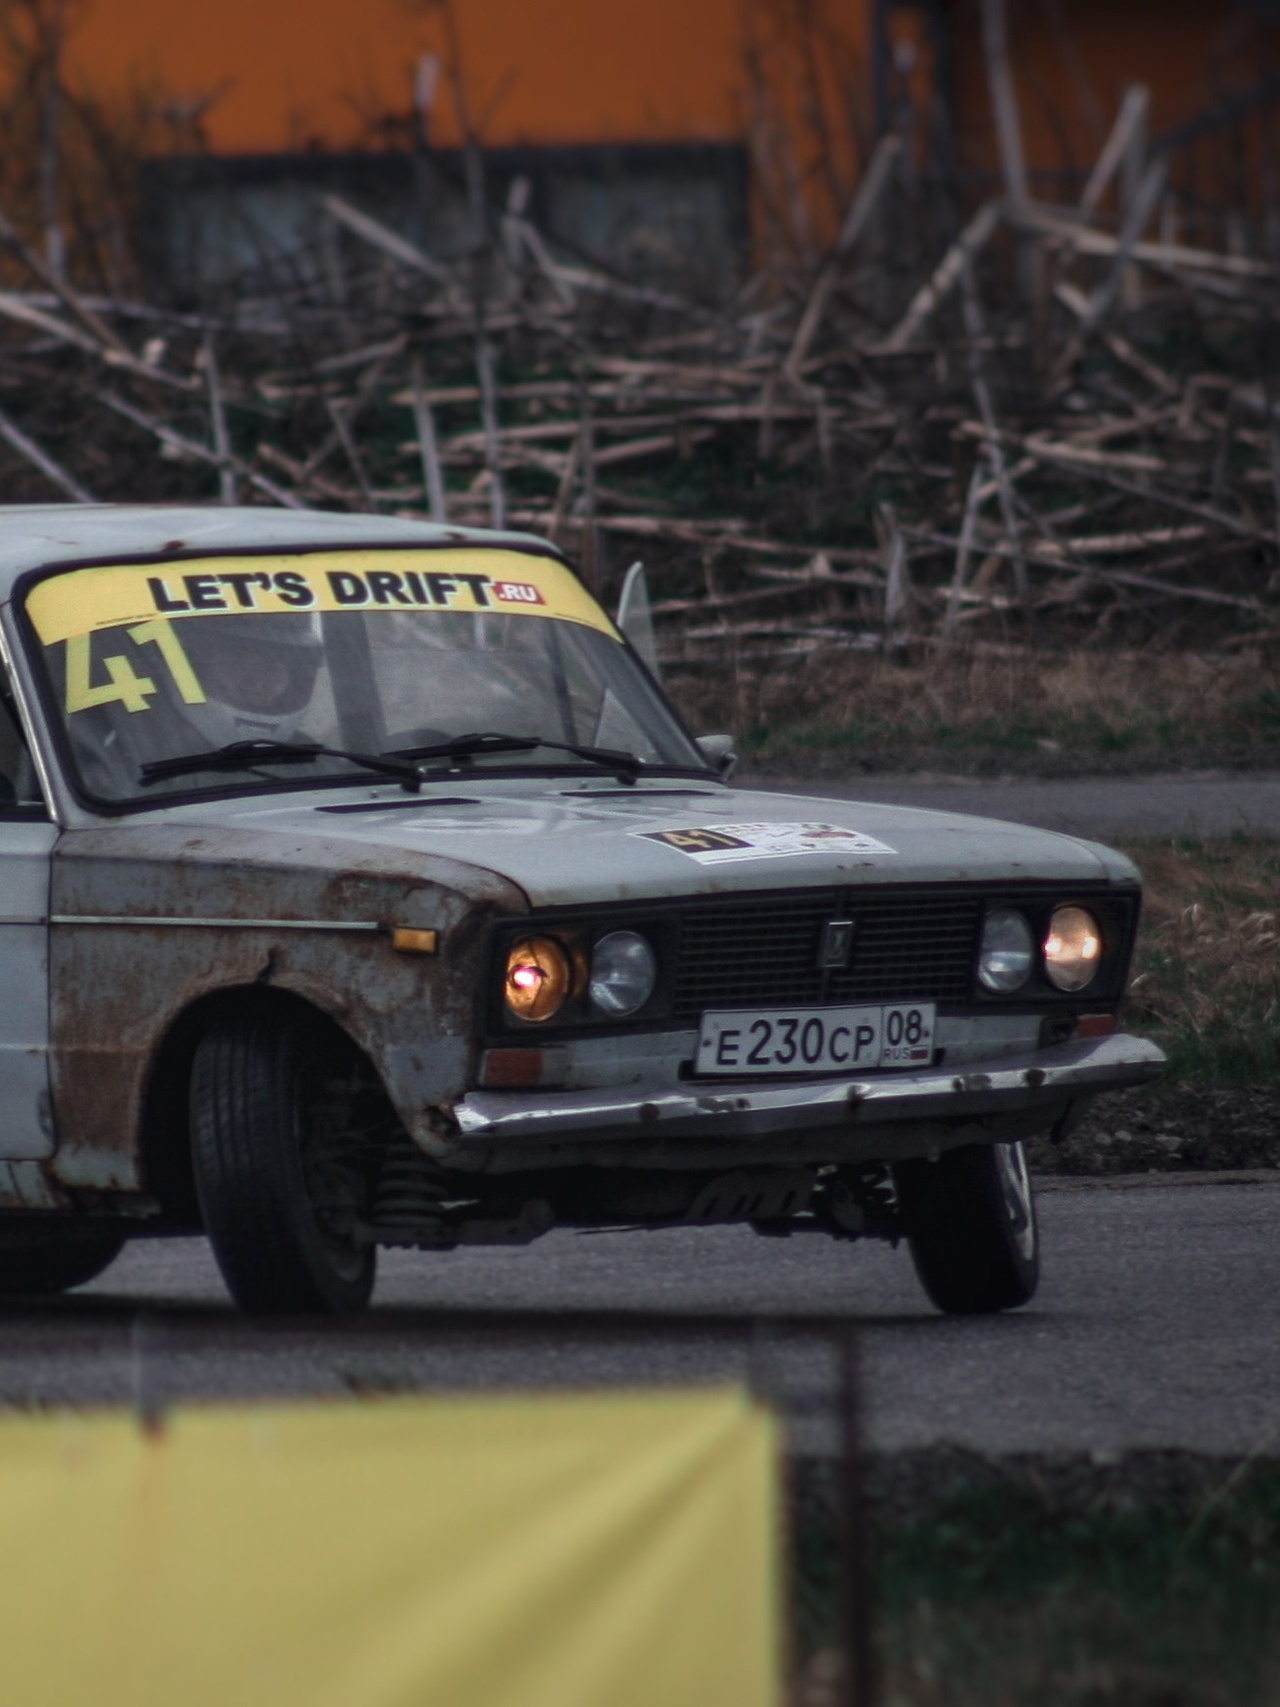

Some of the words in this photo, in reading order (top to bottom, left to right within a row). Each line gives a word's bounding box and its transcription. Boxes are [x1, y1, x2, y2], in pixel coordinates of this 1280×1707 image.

[146, 571, 314, 613] LET'S
[325, 571, 490, 606] DRIFT
[66, 618, 207, 714] 41
[661, 828, 738, 849] 41
[886, 1009, 923, 1046] 08
[883, 1047, 910, 1060] RUS
